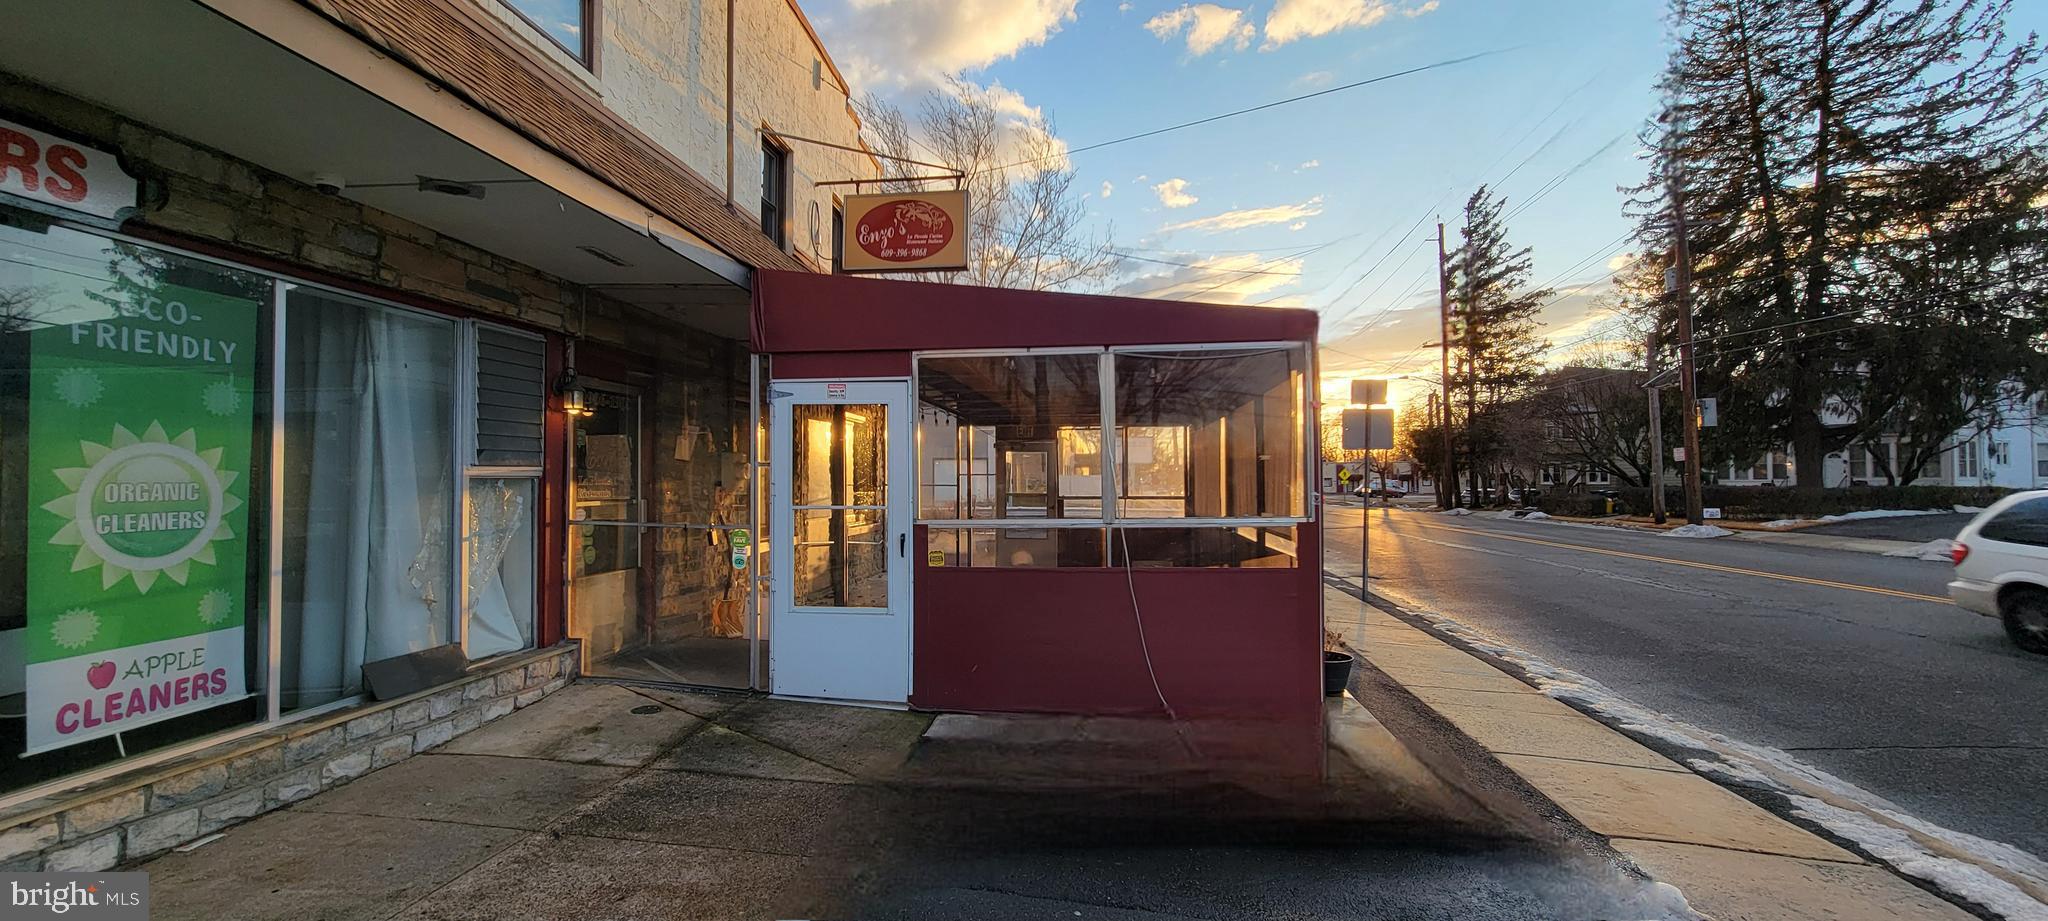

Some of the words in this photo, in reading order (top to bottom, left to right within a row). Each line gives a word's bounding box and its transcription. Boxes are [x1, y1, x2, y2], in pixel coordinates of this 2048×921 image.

[0, 127, 88, 203] RS
[859, 218, 907, 249] Enzo's
[881, 247, 928, 258] 609-396-9868
[71, 322, 237, 364] FRIENDLY
[104, 482, 200, 503] ORGANIC
[96, 510, 207, 535] CLEANERS
[122, 648, 206, 680] APPLE
[55, 667, 228, 735] CLEANERS
